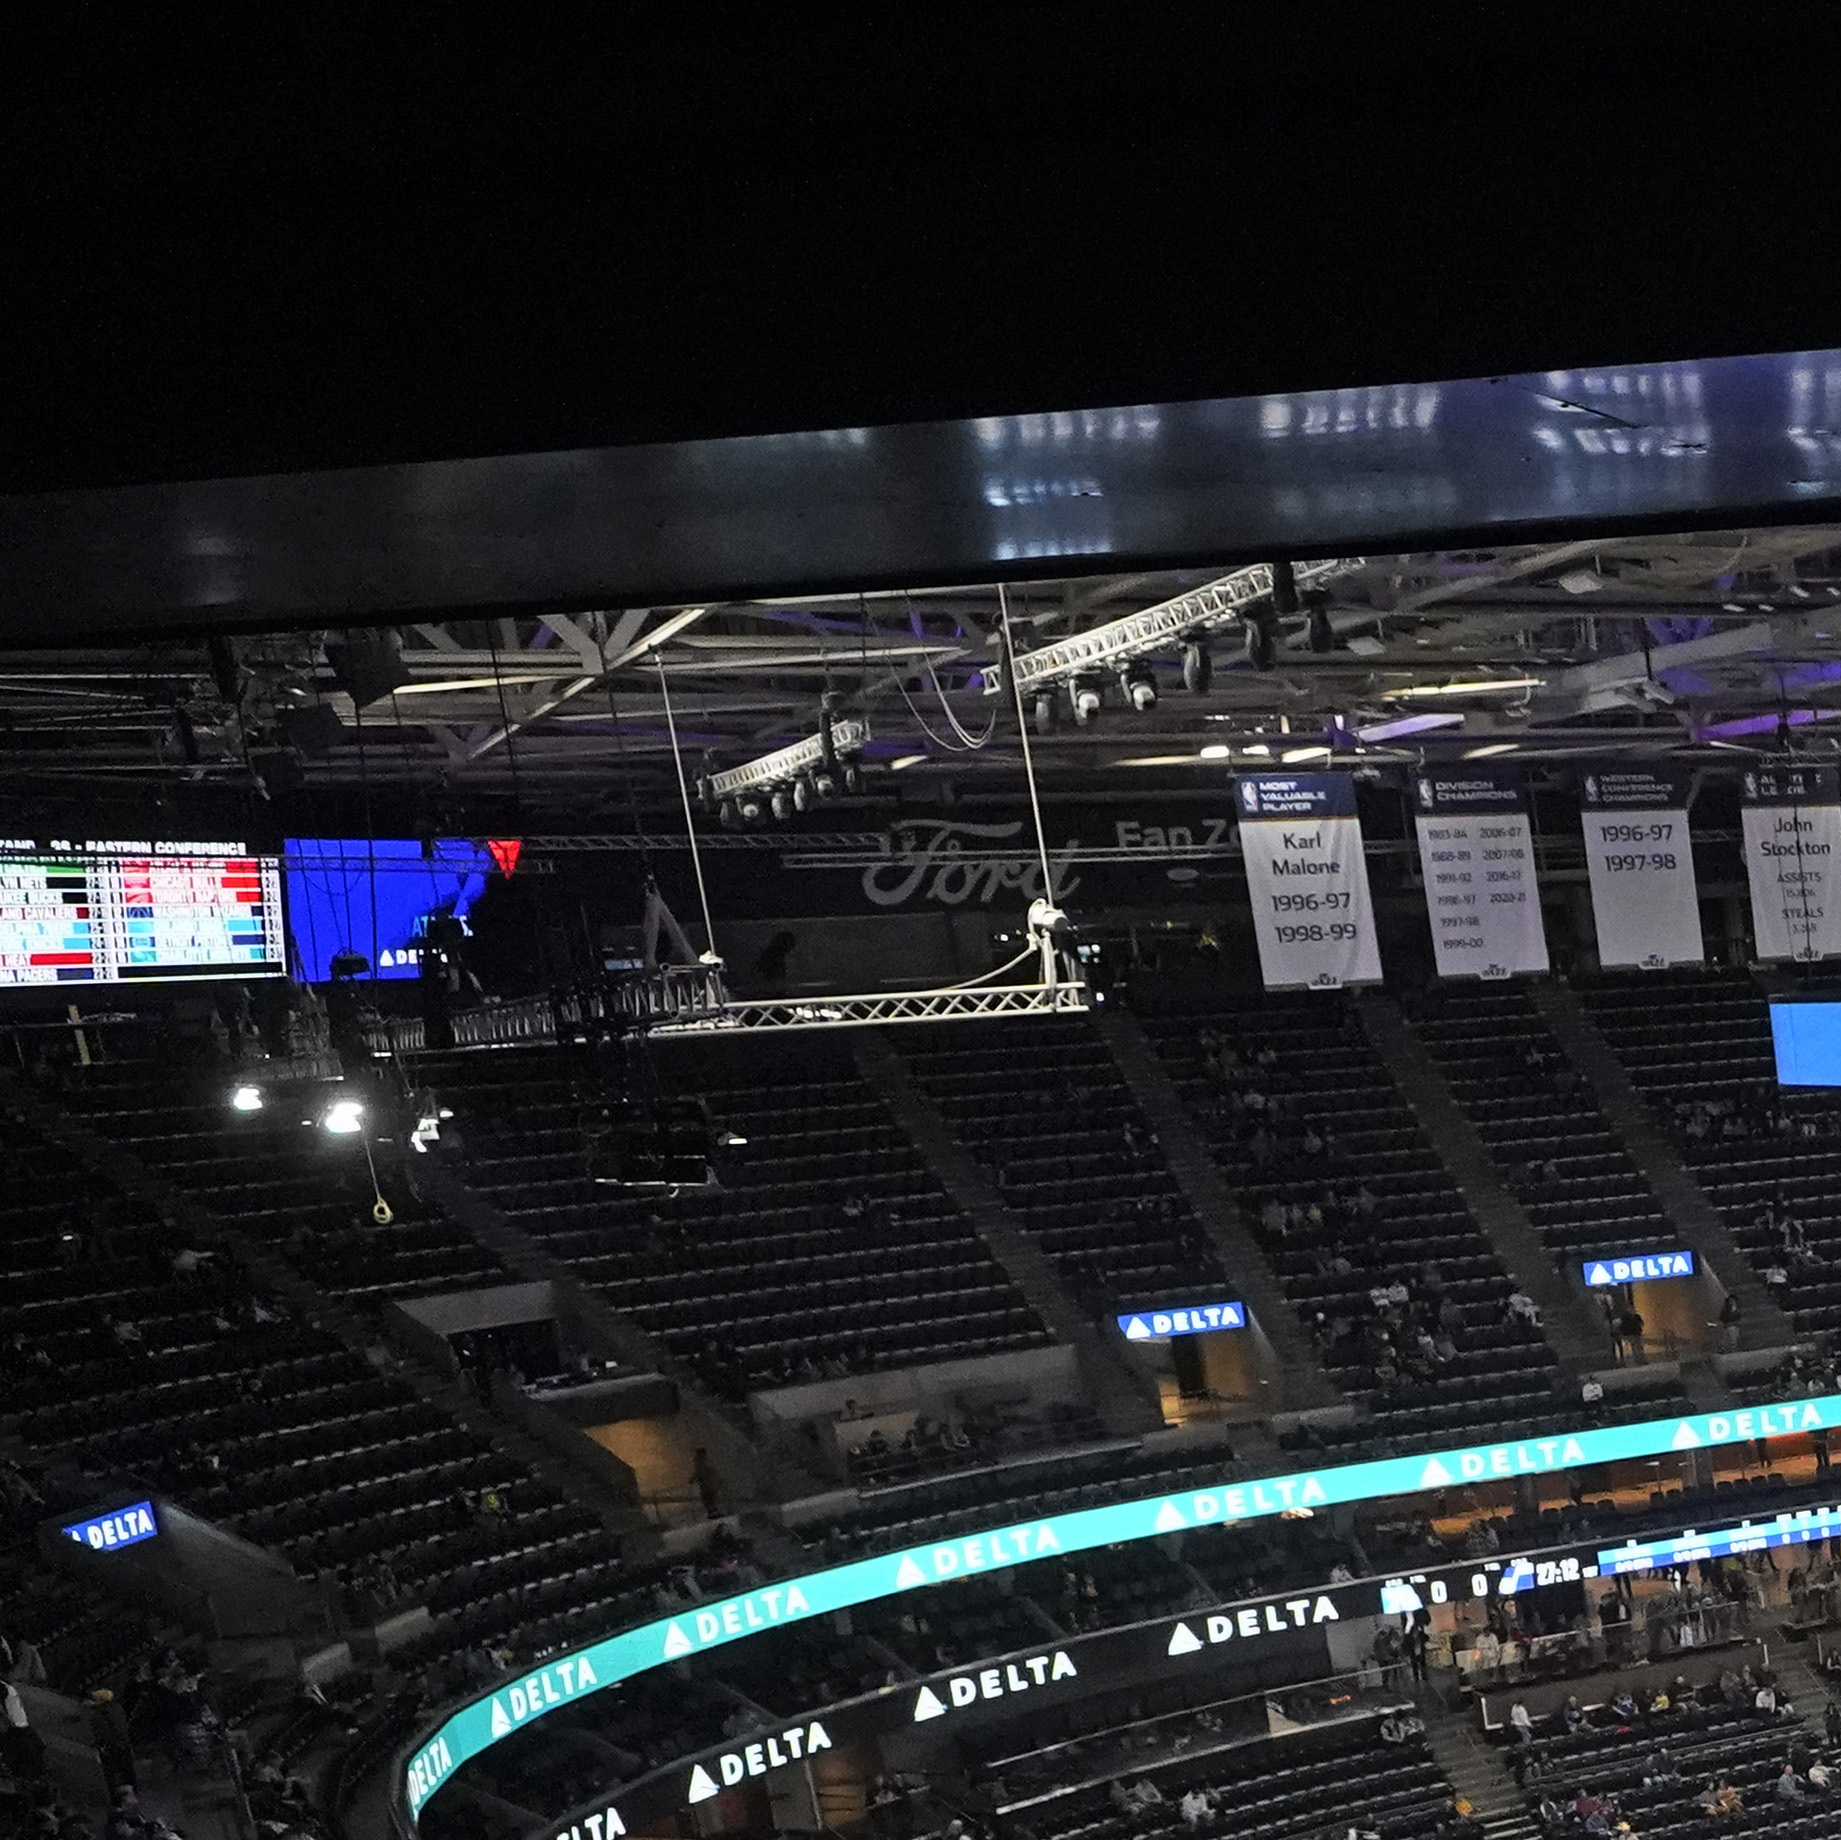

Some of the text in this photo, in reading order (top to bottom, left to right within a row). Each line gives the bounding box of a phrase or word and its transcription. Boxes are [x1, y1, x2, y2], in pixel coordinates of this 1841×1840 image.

[1259, 781, 1298, 792] MOST
[1435, 780, 1495, 791] DIVISION
[1436, 789, 1518, 801] CHAMPIONS
[1262, 801, 1312, 811] PLAYER
[1115, 820, 1193, 849] Fan
[1600, 824, 1674, 843] 1996-97
[1774, 817, 1813, 833] John
[155, 841, 246, 856] CONFERENCE
[1282, 830, 1322, 850] Karl
[1760, 840, 1831, 857] Stockton
[863, 818, 1082, 906] Ford
[1271, 857, 1341, 876] Malone
[1604, 853, 1677, 872] 1997-98
[1271, 891, 1352, 912] 1996-97
[1274, 922, 1358, 944] 1998-99
[1614, 1254, 1690, 1280] DELTA
[1153, 1304, 1240, 1333] DELTA
[1709, 1402, 1823, 1443] DELTA
[1460, 1438, 1586, 1481] DELTA
[1194, 1477, 1327, 1523] DELTA
[87, 1509, 154, 1549] DELTA
[933, 1524, 1061, 1578] DELTA
[1430, 1557, 1580, 1604] 0 0 27:12
[696, 1584, 811, 1643] DELTA
[1206, 1595, 1340, 1646] DELTA
[509, 1656, 598, 1723] DELTA
[948, 1650, 1078, 1708] DELTA
[720, 1720, 833, 1786] DELTA
